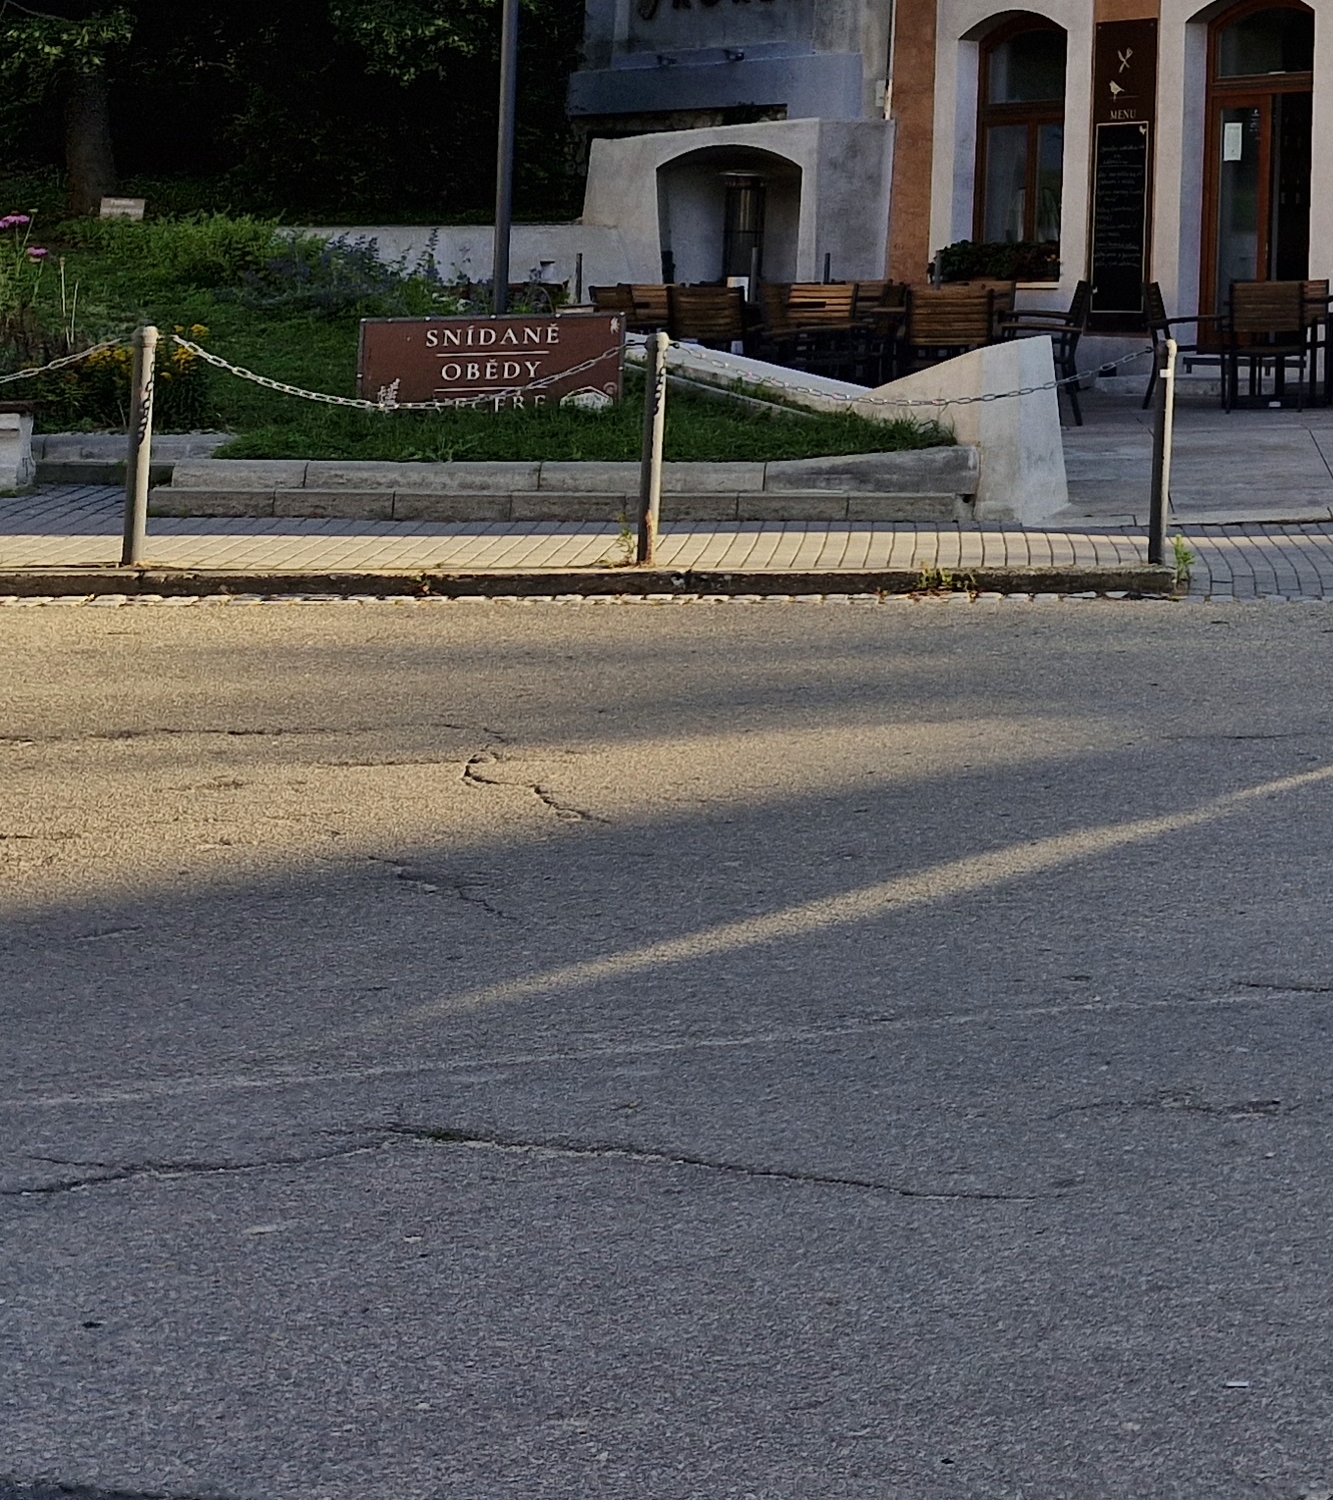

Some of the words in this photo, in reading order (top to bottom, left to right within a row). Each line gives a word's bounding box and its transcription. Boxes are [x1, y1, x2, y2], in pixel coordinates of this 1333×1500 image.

[1109, 109, 1136, 120] MENU
[425, 323, 560, 348] SNÍDANĚ
[441, 359, 542, 381] OBĚDY
